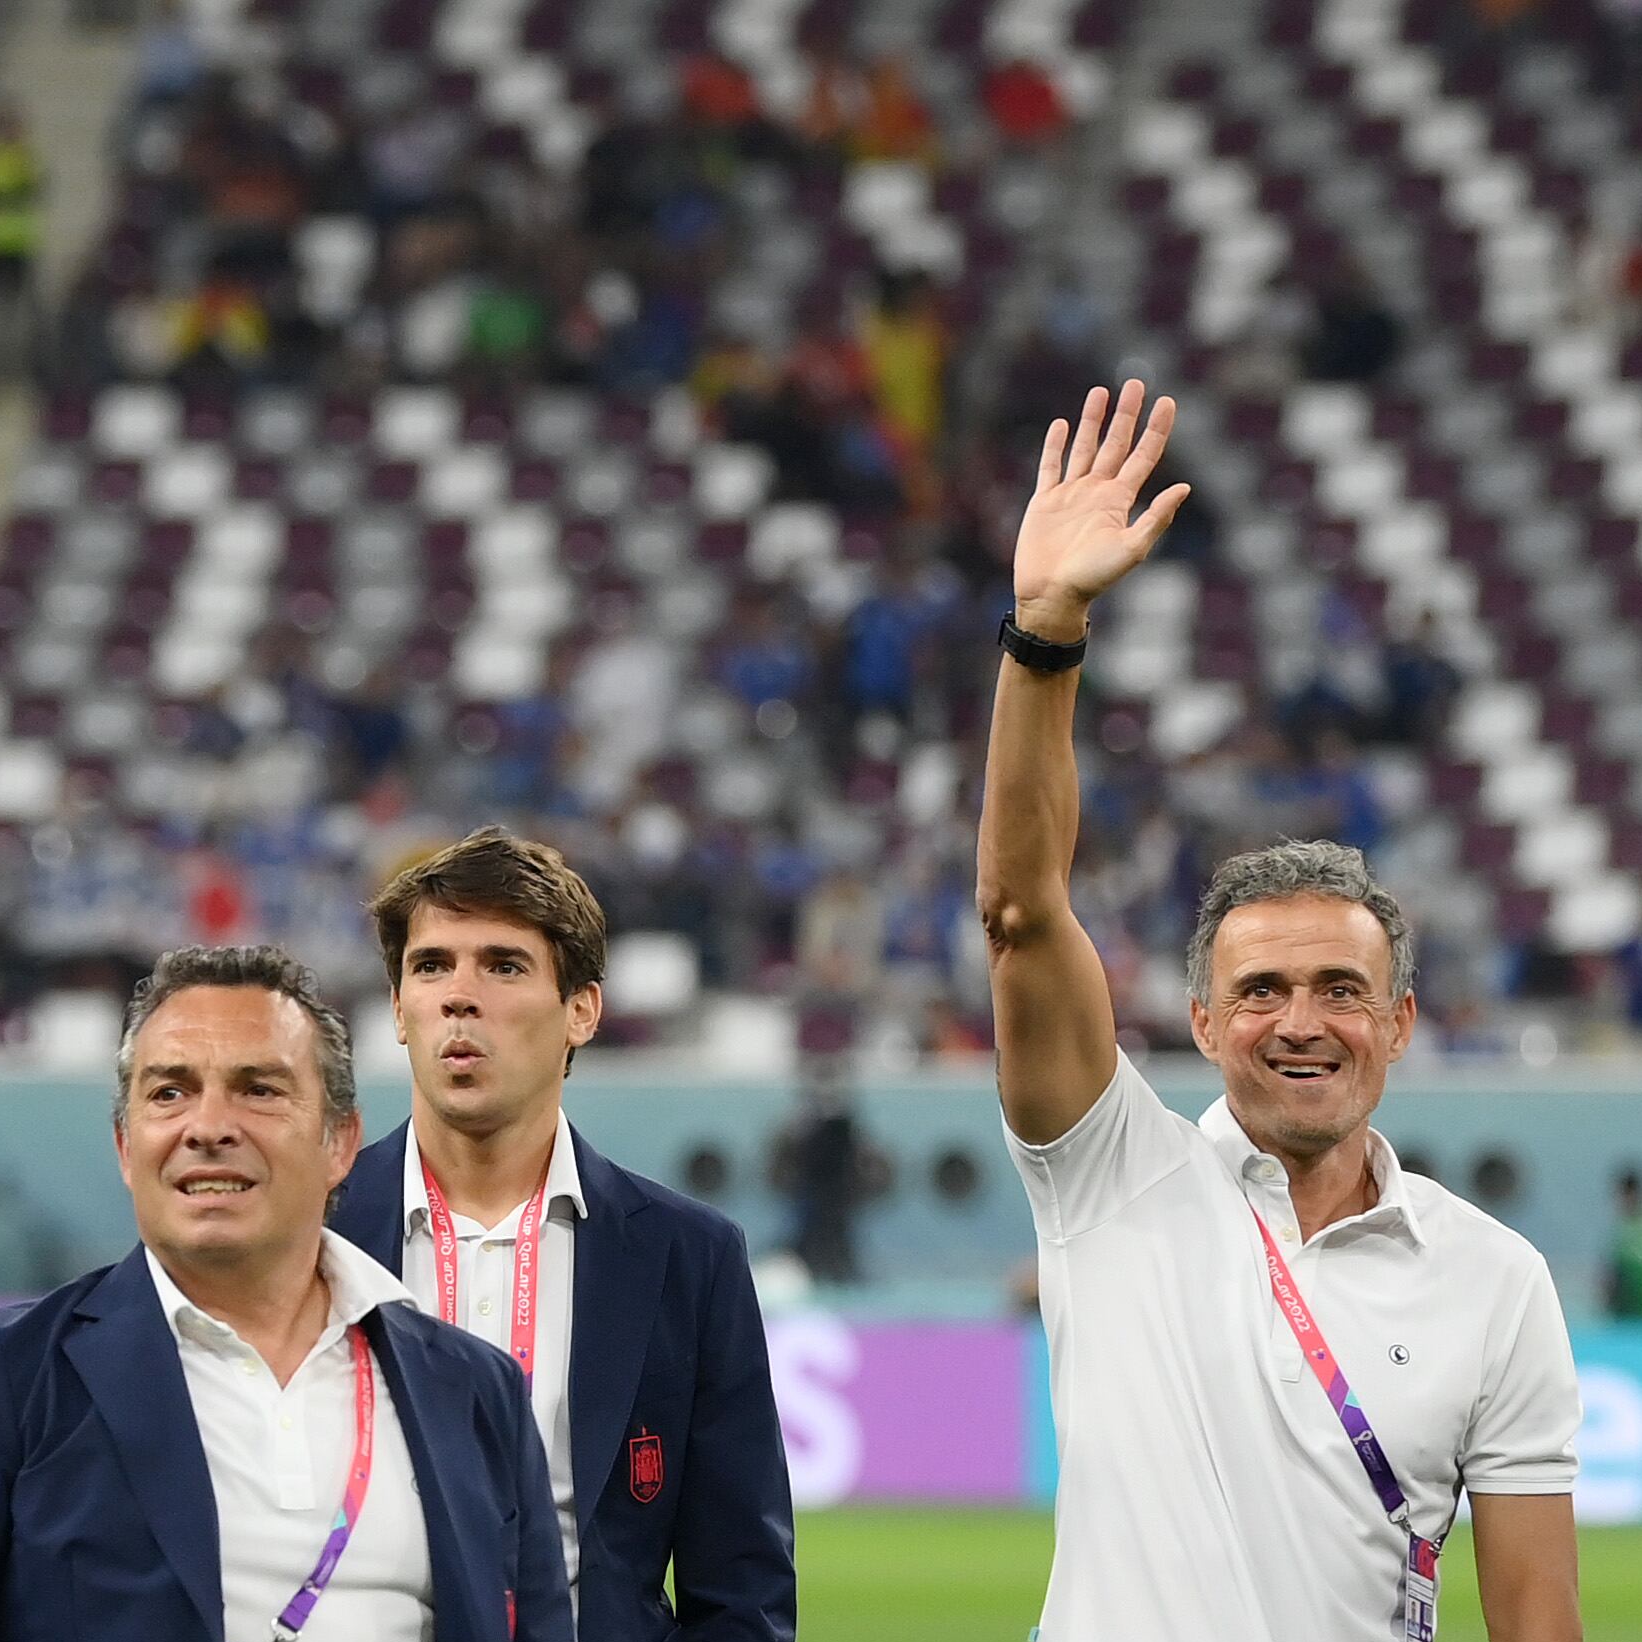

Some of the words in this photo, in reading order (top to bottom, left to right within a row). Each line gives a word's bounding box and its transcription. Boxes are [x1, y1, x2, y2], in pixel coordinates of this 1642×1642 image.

[522, 1214, 534, 1237] CUP
[517, 1241, 533, 1326] Qatar2022
[1267, 1255, 1311, 1333] Qatar2022
